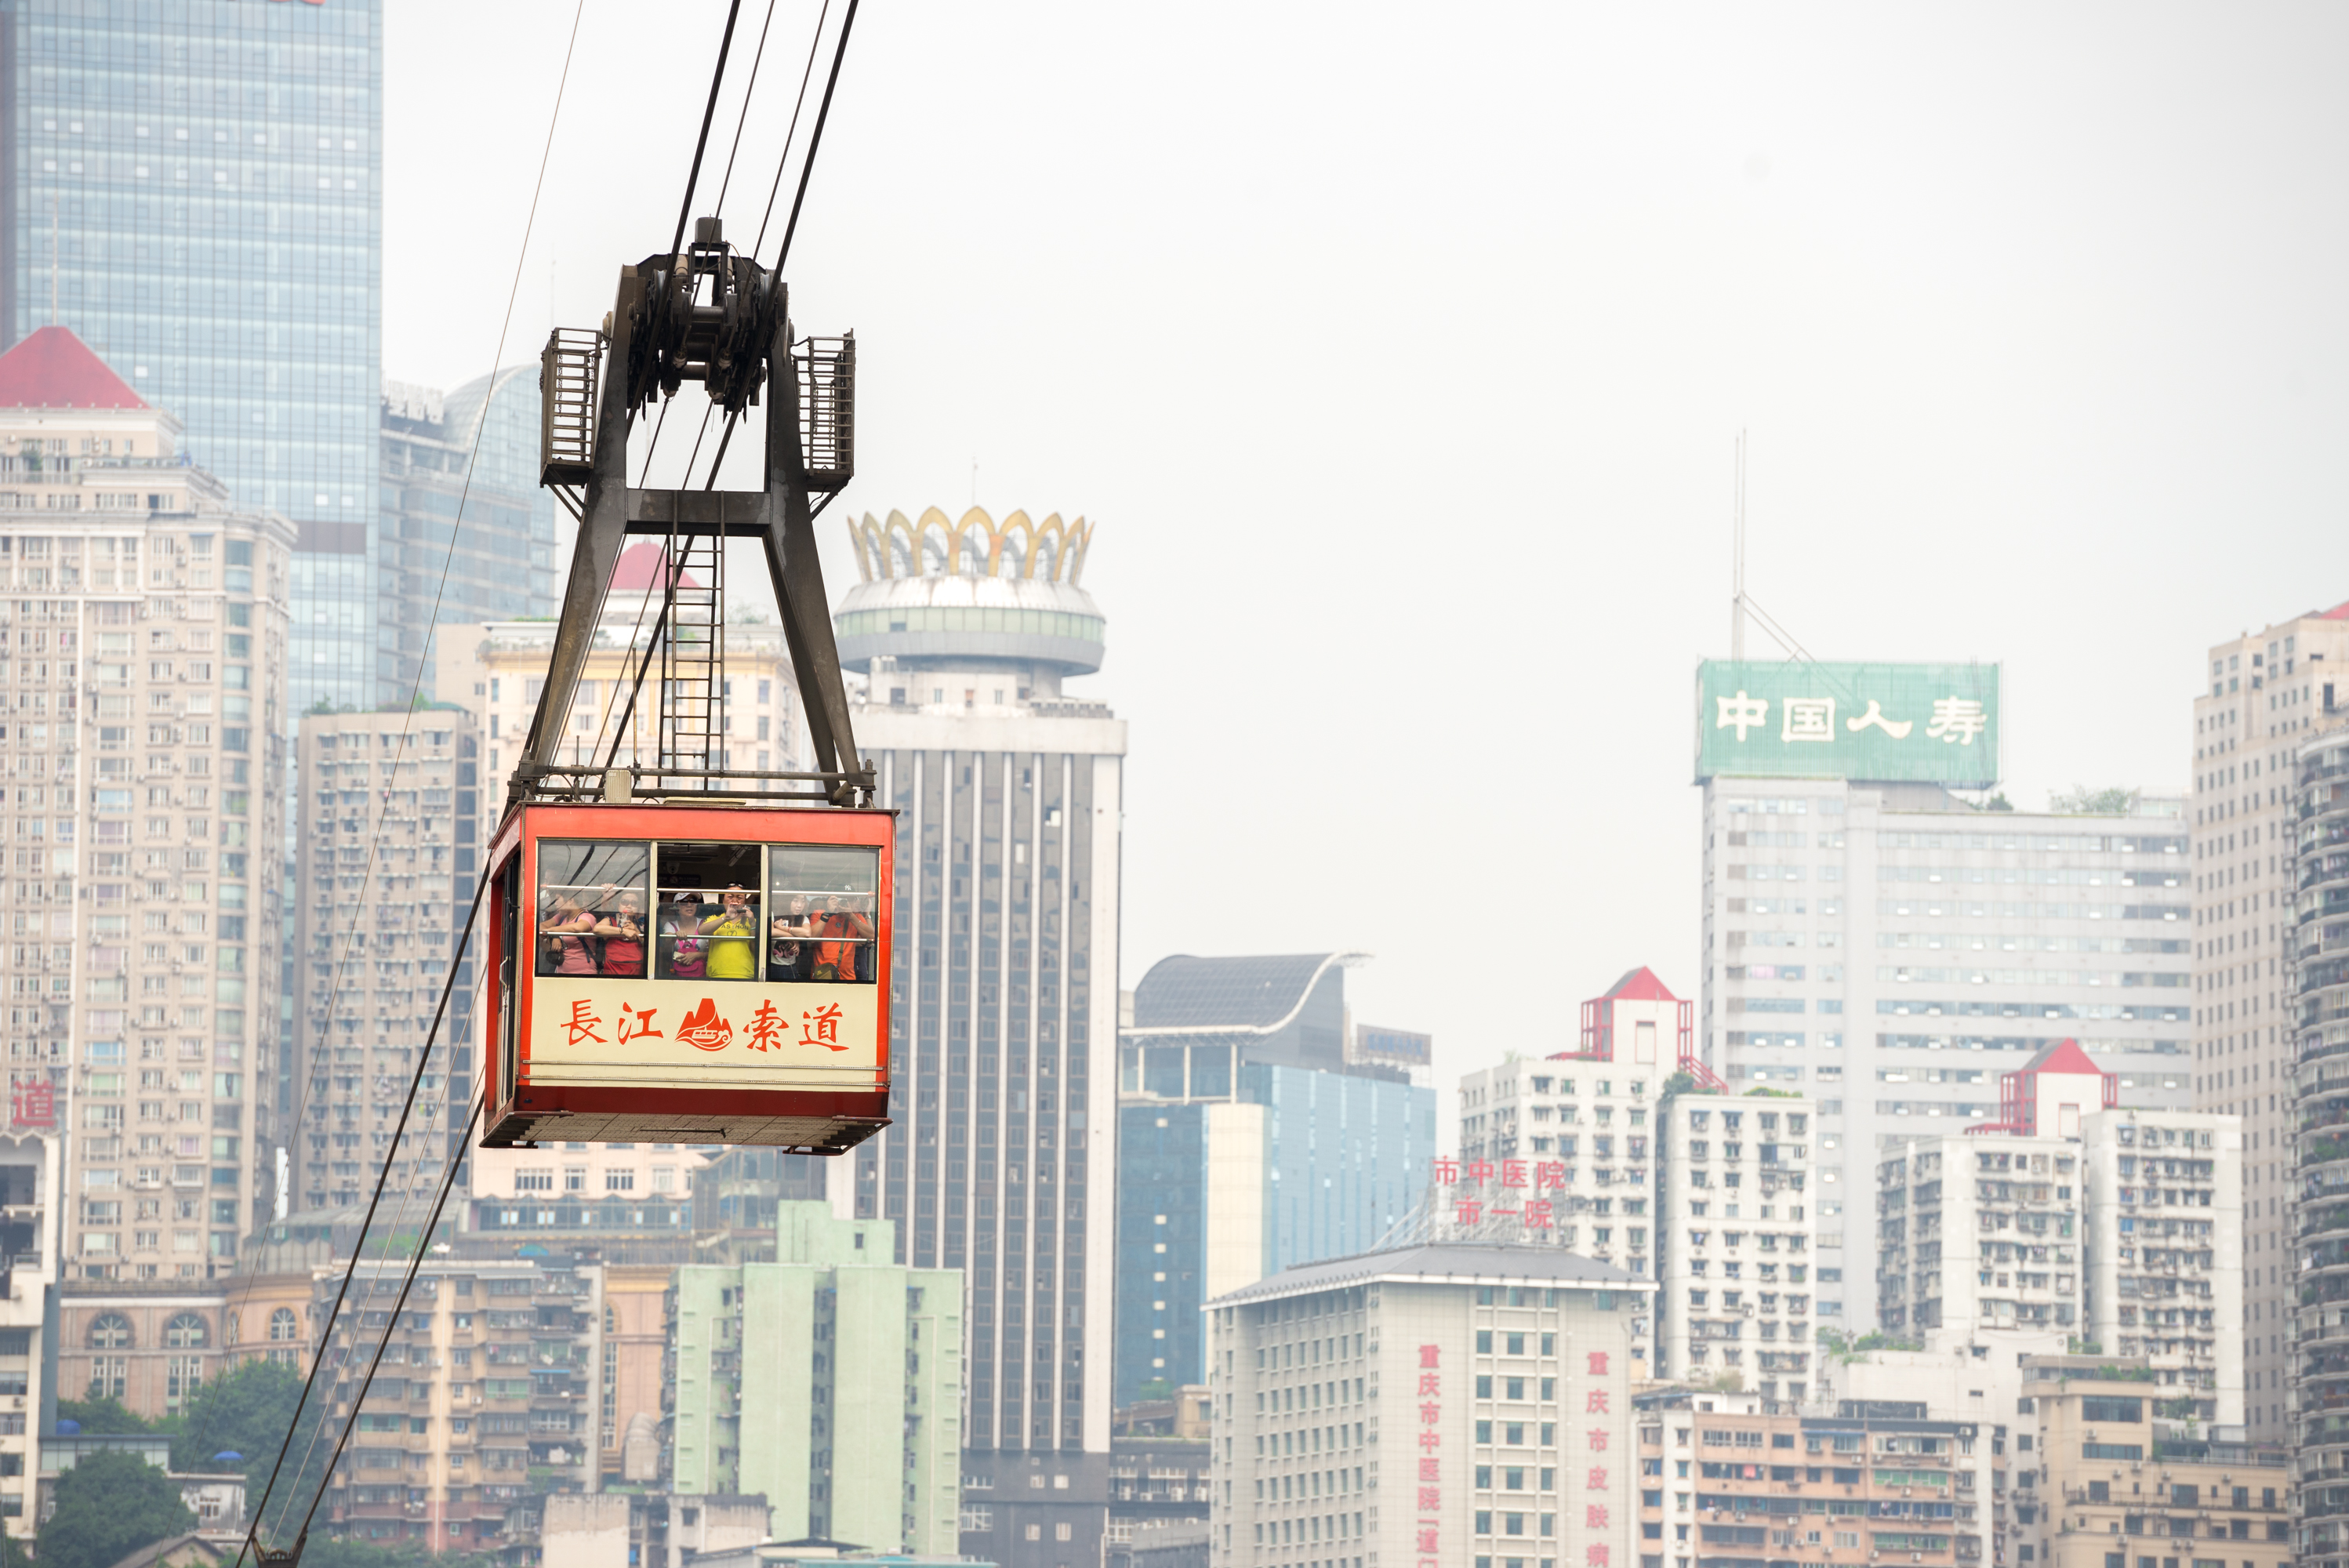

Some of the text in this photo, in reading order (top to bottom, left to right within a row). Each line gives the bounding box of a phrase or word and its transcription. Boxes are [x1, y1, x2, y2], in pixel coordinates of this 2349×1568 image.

[1715, 689, 1988, 746] 中国人寿
[13, 1080, 55, 1127] 道
[1432, 1155, 1566, 1189] 市中医院
[1455, 1195, 1554, 1229] 市一院
[1586, 1352, 1610, 1568] 重庆市皮肤病
